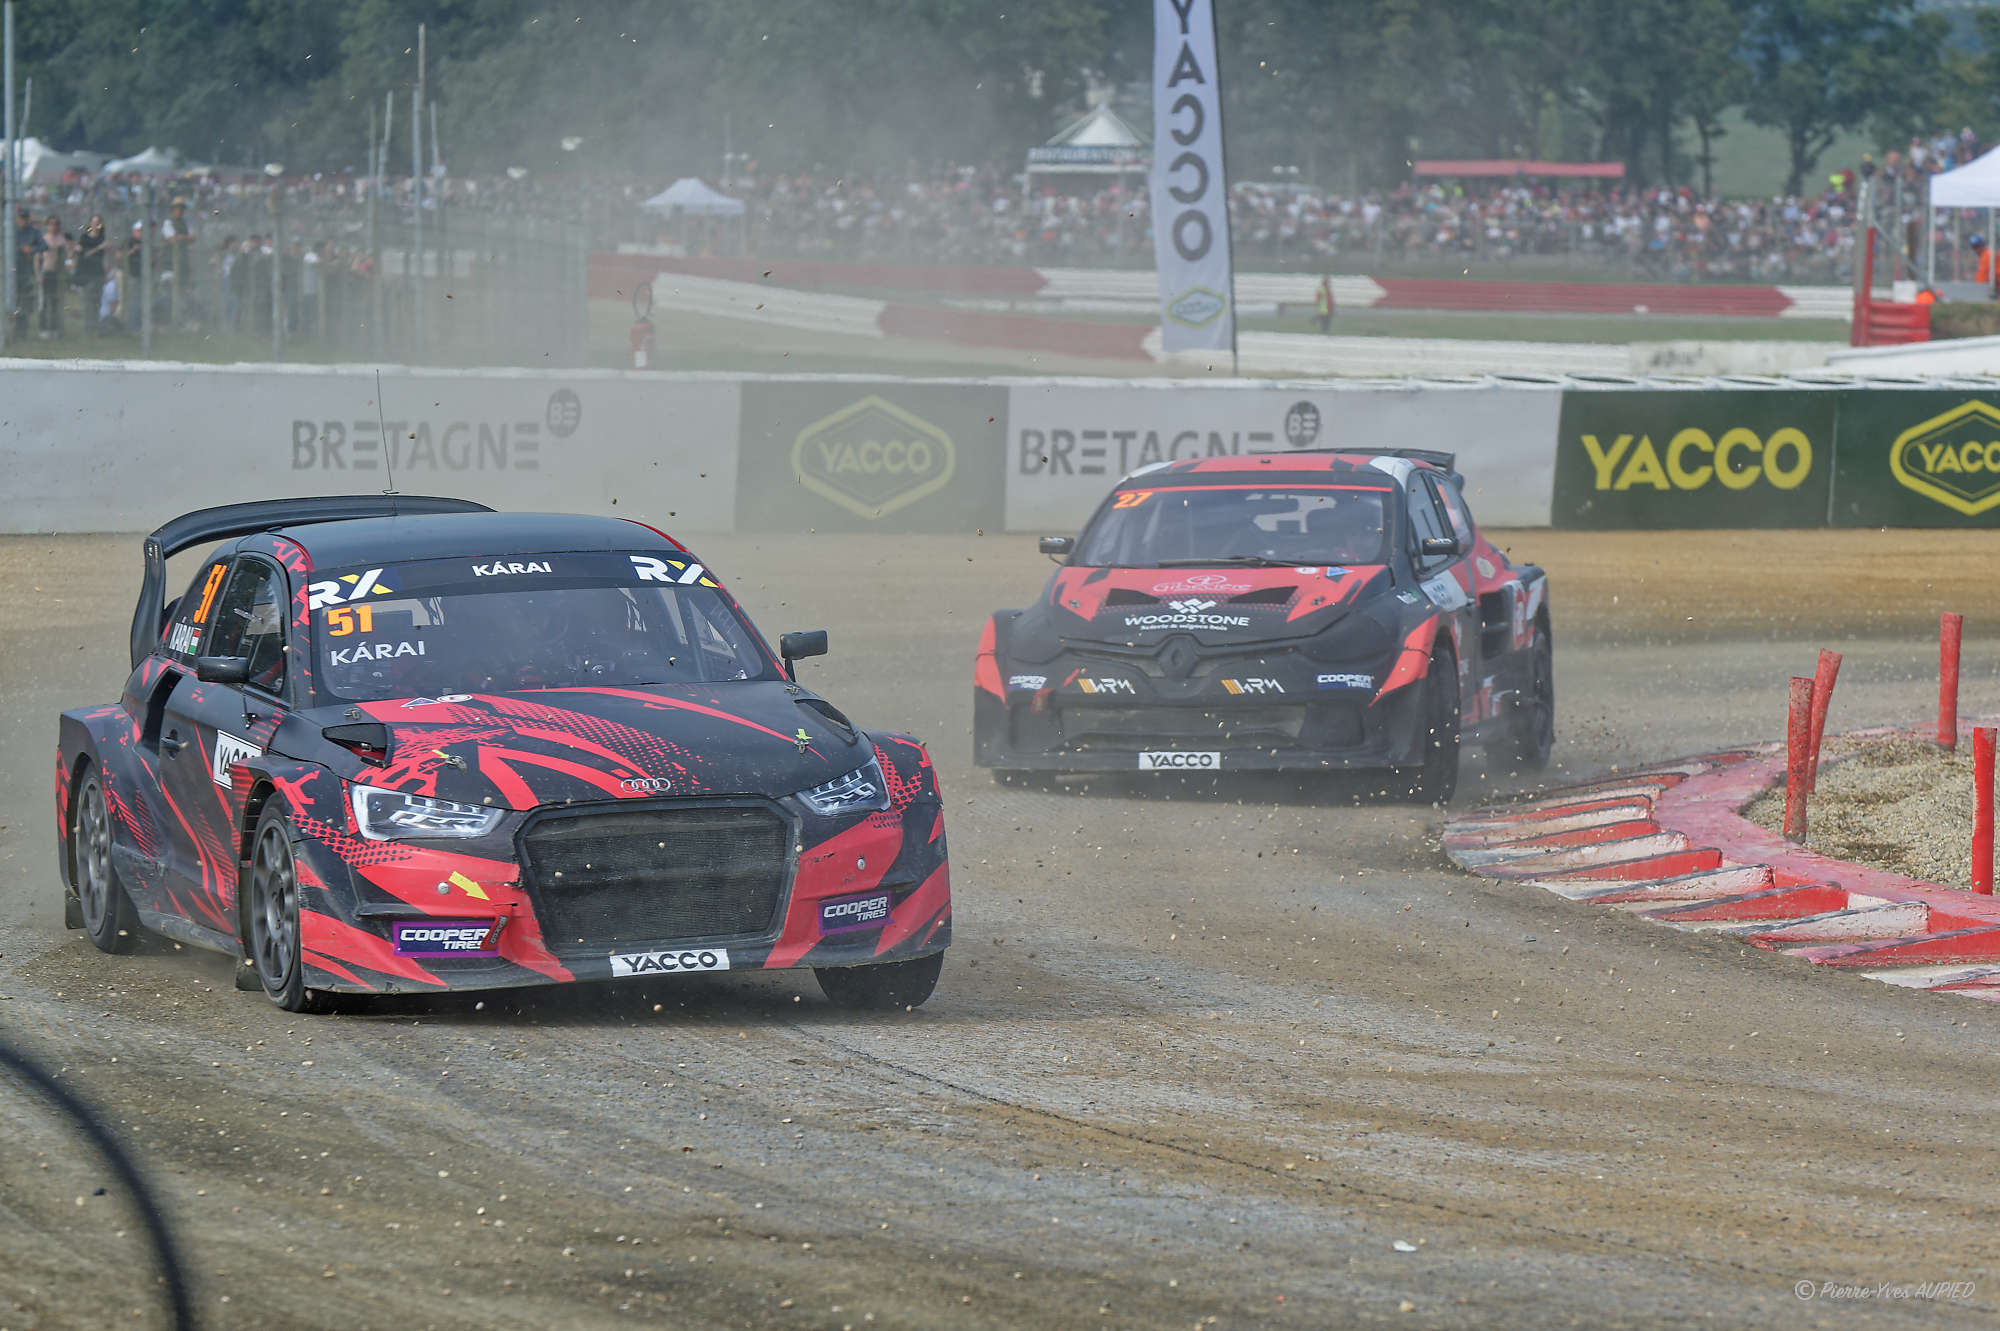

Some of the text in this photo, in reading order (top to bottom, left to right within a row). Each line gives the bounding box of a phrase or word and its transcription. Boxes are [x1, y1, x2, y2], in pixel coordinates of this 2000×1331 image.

[291, 420, 540, 471] BRETAGNE
[819, 440, 931, 473] YACCO
[1581, 427, 1812, 490] YACCO
[1112, 491, 1153, 509] 27
[472, 561, 552, 577] KÁRAI
[193, 564, 227, 624] 51
[327, 604, 373, 637] 51
[1125, 614, 1250, 626] WOODSTONE
[331, 640, 425, 666] KÁRAI
[1317, 674, 1371, 683] COOPER
[1148, 754, 1212, 767] YACCO
[823, 896, 887, 918] COOPER
[856, 908, 887, 921] TIRES
[622, 951, 718, 973] YACCO
